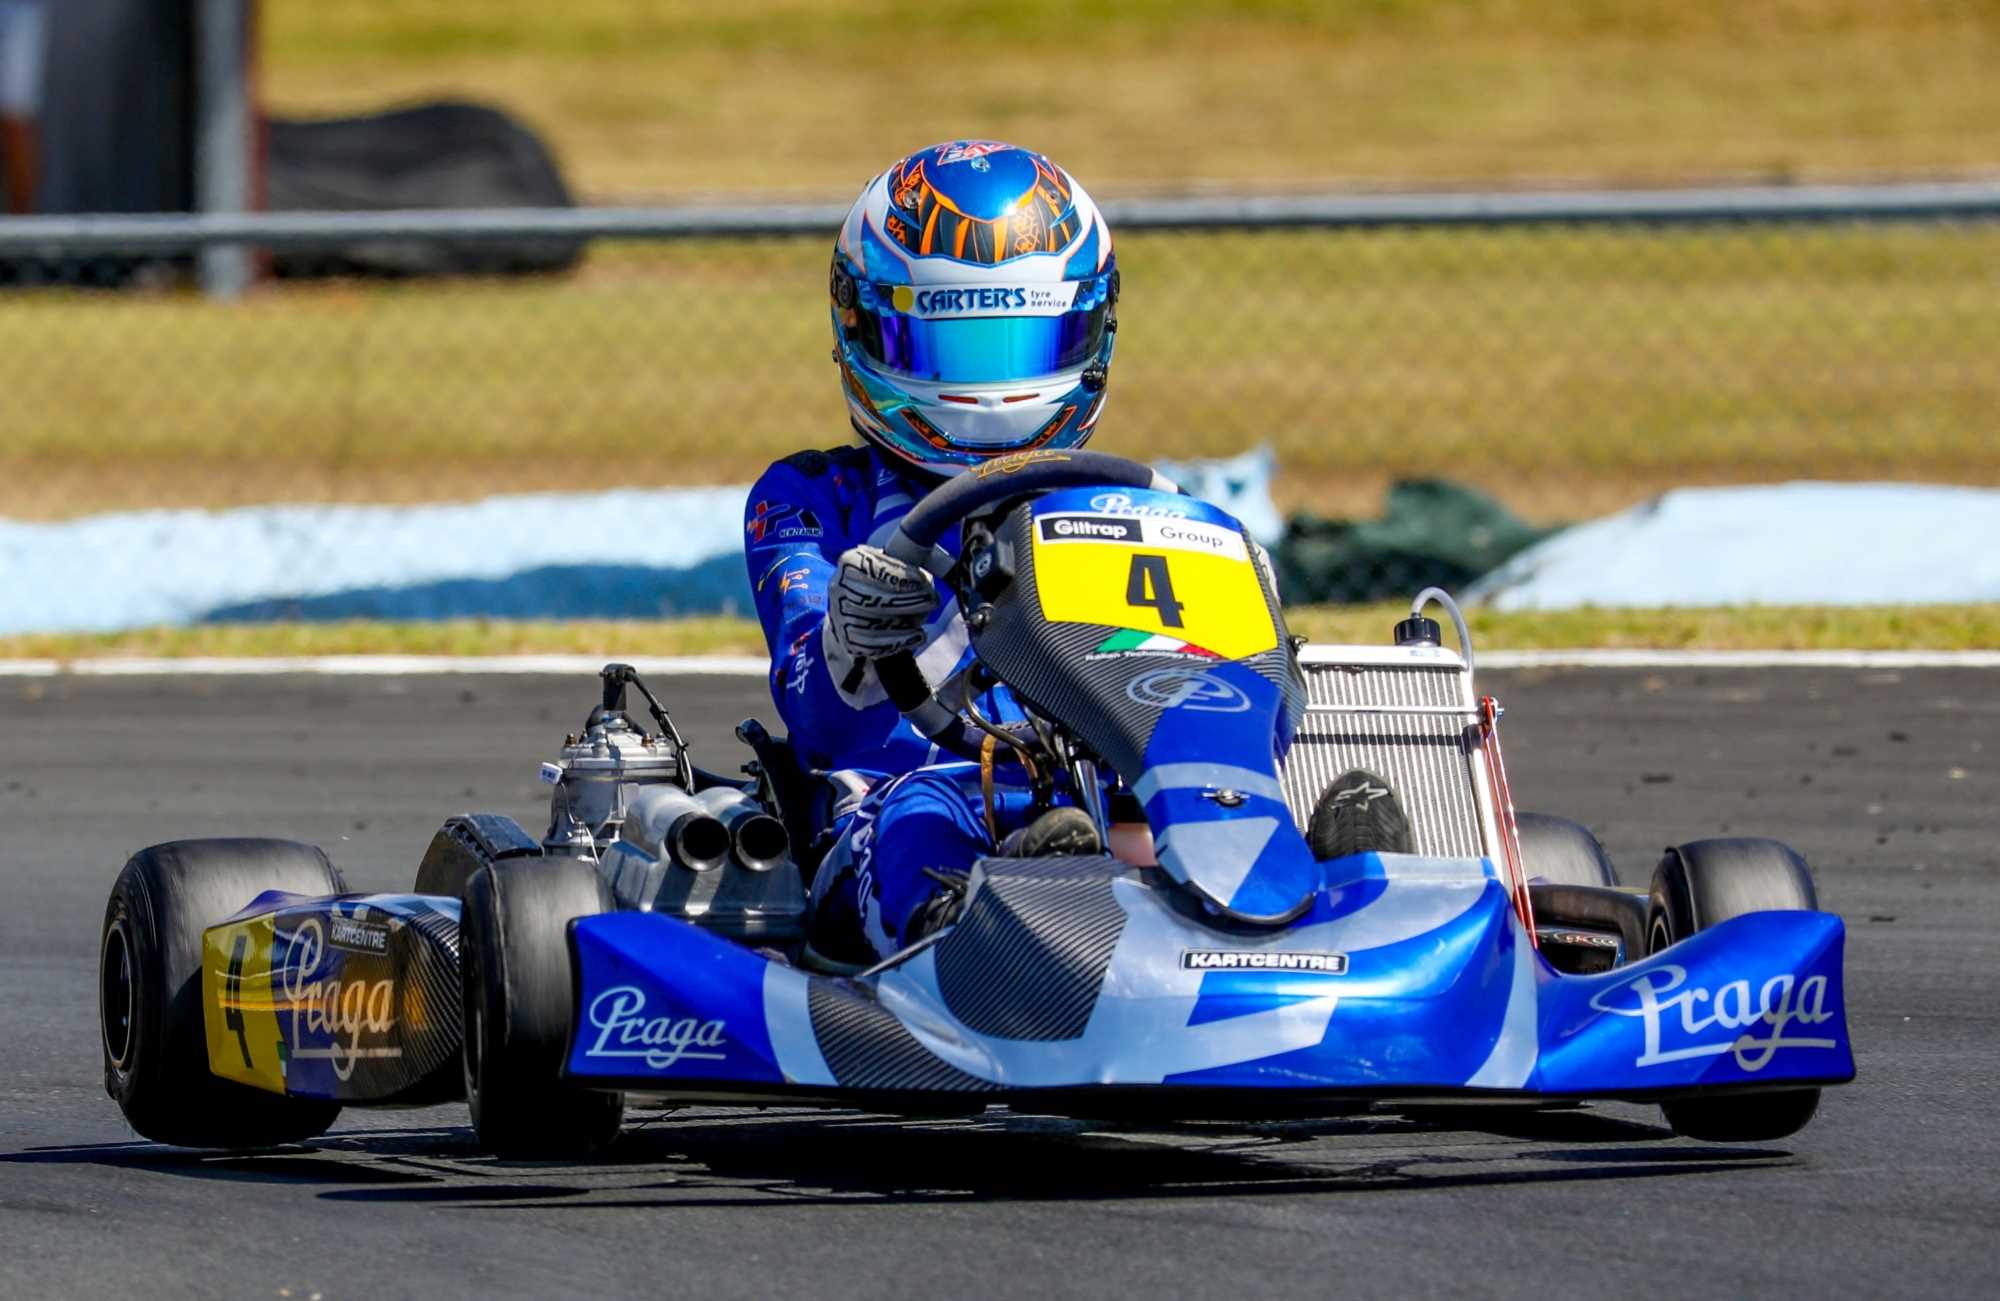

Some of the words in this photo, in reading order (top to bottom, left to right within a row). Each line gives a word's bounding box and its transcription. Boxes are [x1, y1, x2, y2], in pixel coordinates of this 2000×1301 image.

[916, 287, 1026, 314] CARTER'S
[1030, 290, 1051, 299] tyre
[1030, 299, 1067, 308] service
[1053, 520, 1128, 539] Giltrap
[1160, 526, 1223, 548] Group
[1125, 553, 1185, 629] 4
[1190, 953, 1340, 970] KARTCENTRE
[283, 918, 403, 1081] Praga
[585, 985, 728, 1069] Praga
[1590, 964, 1837, 1072] Praga
